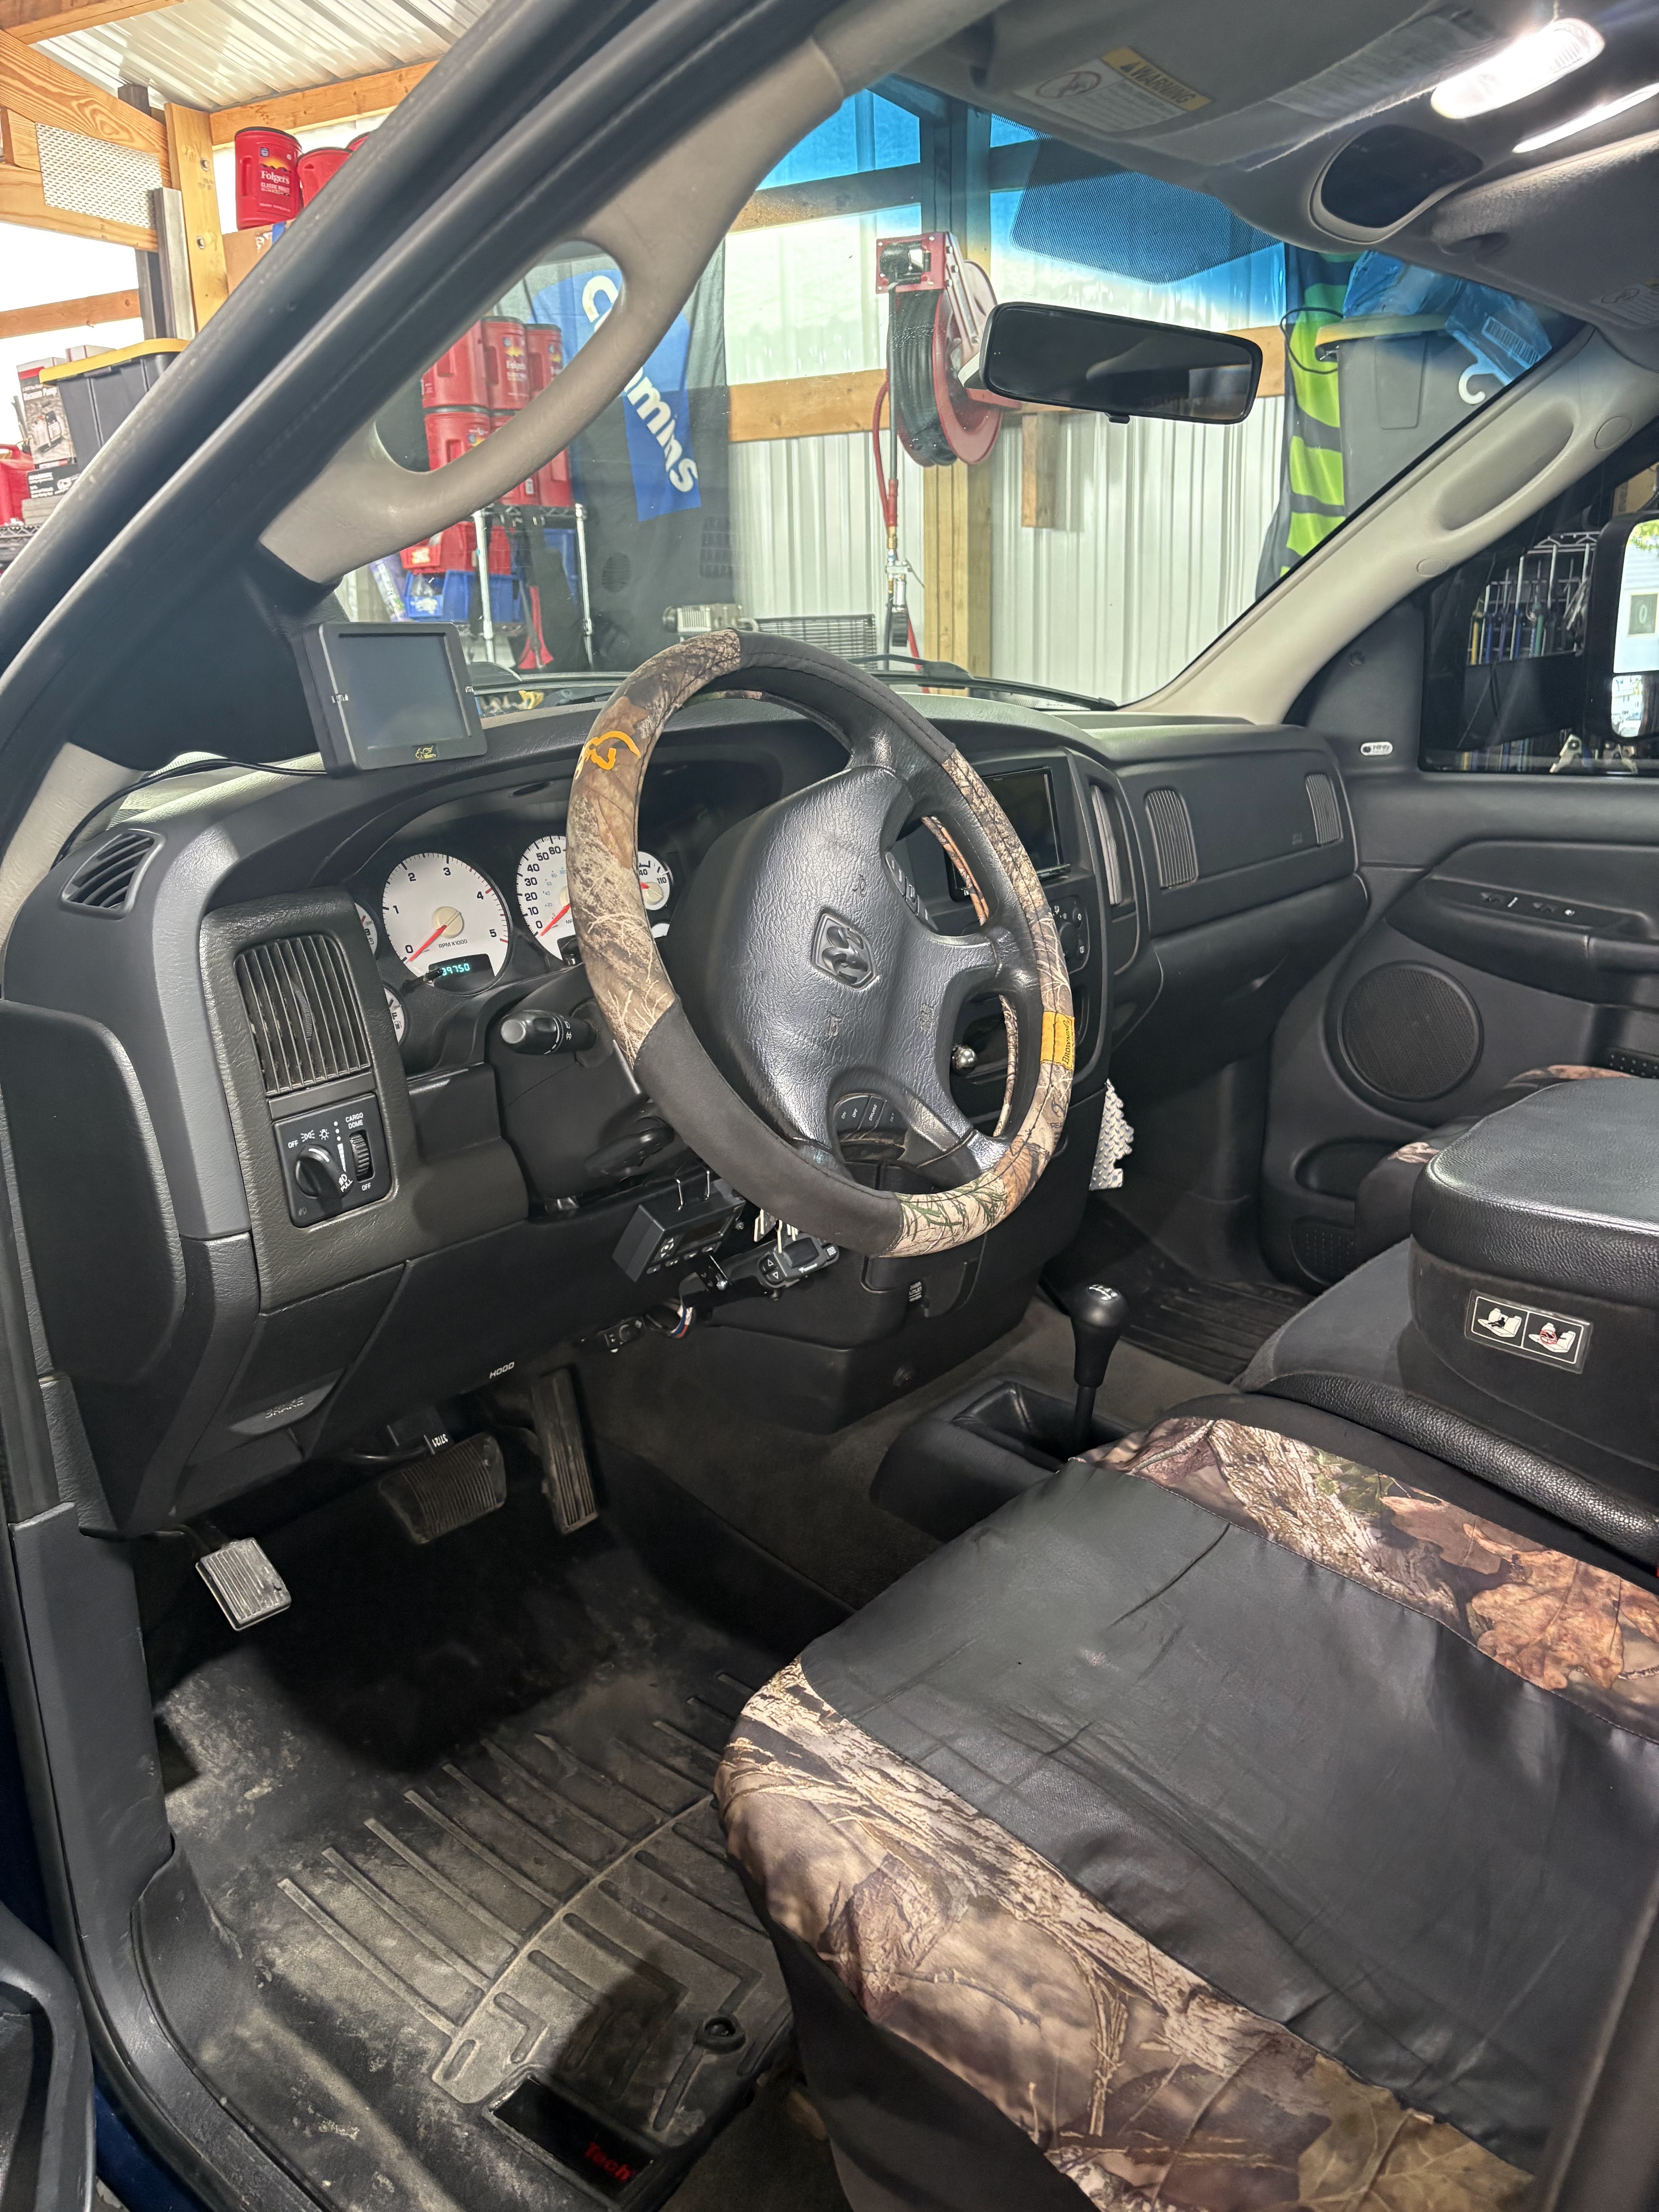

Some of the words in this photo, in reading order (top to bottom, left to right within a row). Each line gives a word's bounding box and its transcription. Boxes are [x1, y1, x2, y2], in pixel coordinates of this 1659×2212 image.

[1132, 65, 1197, 104] WARNING
[261, 171, 290, 184] Folgers
[548, 846, 561, 855] 60
[536, 852, 549, 861] 50
[443, 867, 451, 876] 3
[527, 864, 540, 872] 40
[408, 872, 416, 882] 2
[524, 877, 538, 886] 30
[477, 891, 484, 900] 4
[524, 892, 538, 902] 20
[393, 905, 399, 914] 1
[527, 906, 539, 915] 10
[536, 921, 543, 929] 0
[489, 929, 497, 938] 5
[438, 940, 451, 948] RPM
[405, 945, 413, 953] 0
[869, 1104, 877, 1121] CRUISE
[345, 1113, 363, 1123] CARGO
[348, 1120, 363, 1129] DOME
[288, 1140, 299, 1149] OFF
[340, 1179, 353, 1192] PULL
[362, 1183, 371, 1192] OFF
[489, 1361, 515, 1379] HOOD
